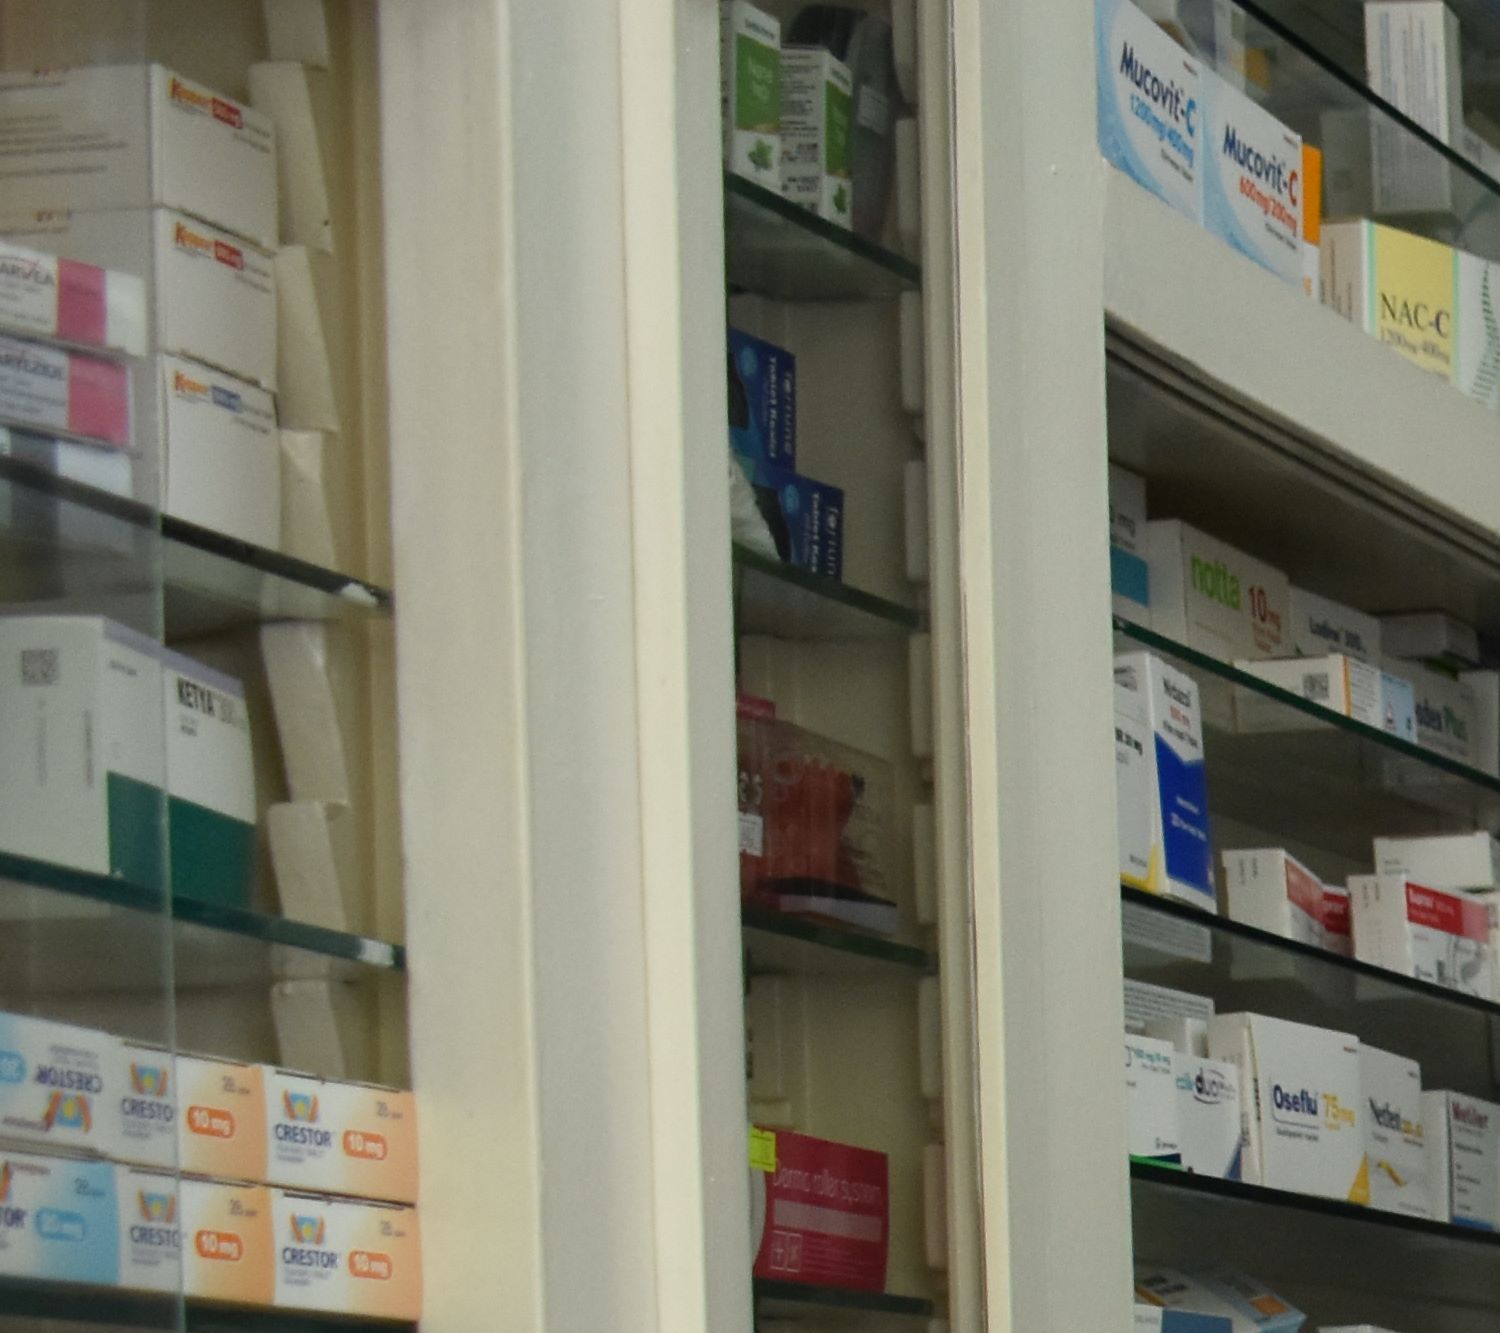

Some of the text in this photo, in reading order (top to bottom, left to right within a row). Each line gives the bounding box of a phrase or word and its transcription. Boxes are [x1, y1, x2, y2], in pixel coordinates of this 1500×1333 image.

[1120, 42, 1197, 139] Mucovit-C
[1223, 122, 1299, 207] Mucovit-C
[1380, 292, 1451, 338] NAC-C
[1272, 1084, 1319, 1118] Oseflu
[275, 1123, 331, 1148] CRESTOR
[282, 1246, 338, 1269] CRESTOR
